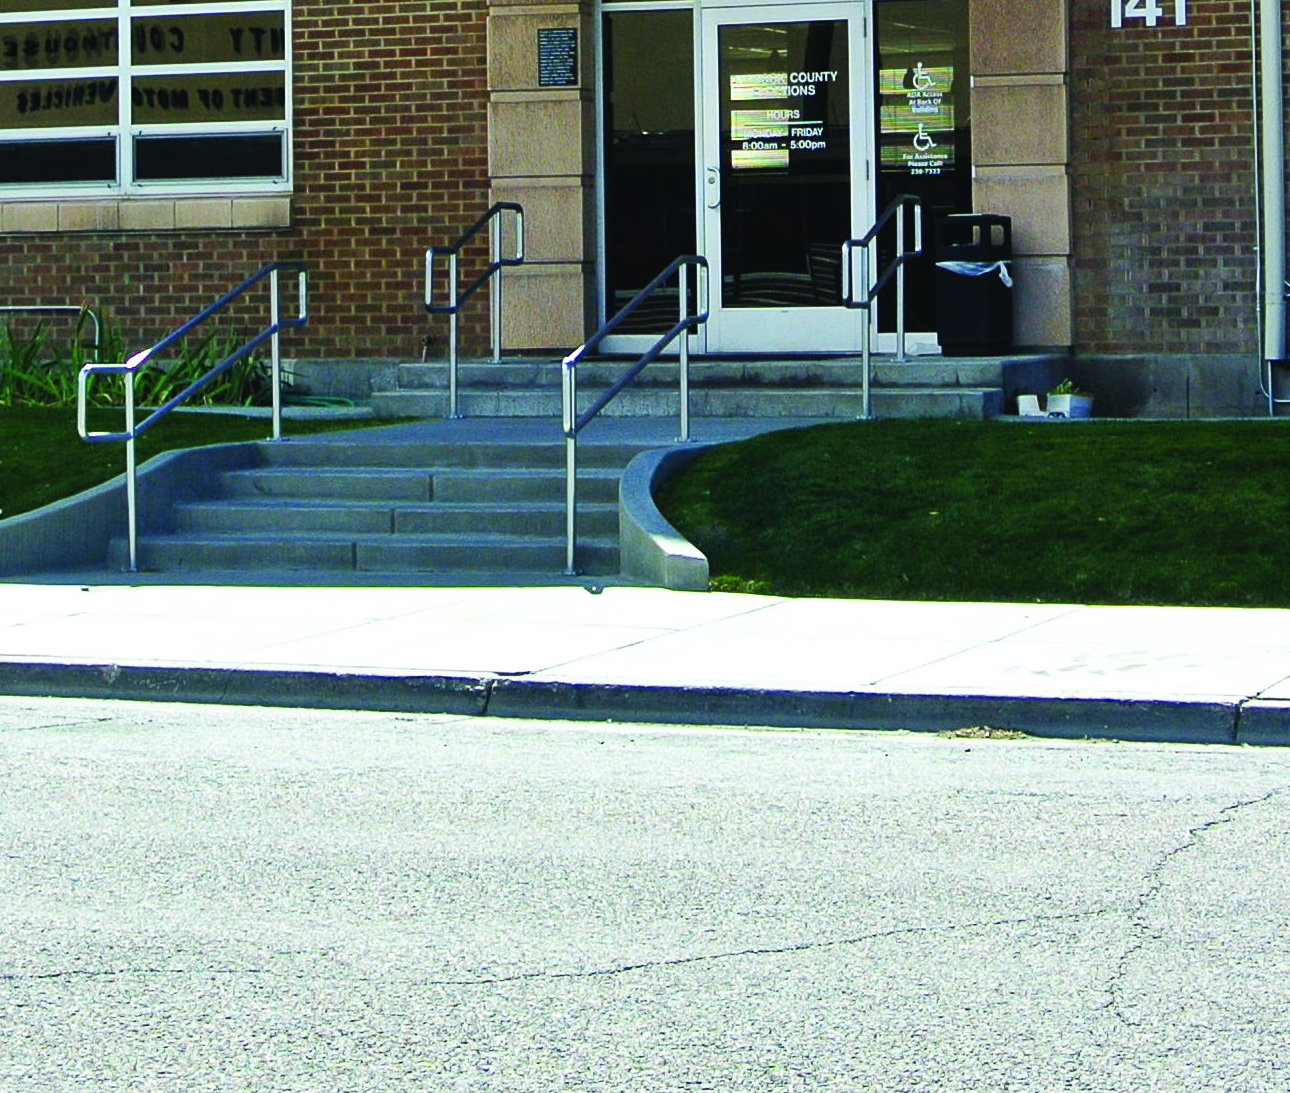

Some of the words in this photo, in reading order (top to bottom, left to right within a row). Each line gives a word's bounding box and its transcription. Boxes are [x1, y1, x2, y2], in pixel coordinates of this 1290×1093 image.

[789, 71, 838, 83] COUNTY
[766, 110, 800, 120] HOURS
[791, 127, 823, 137] FRIDAY
[790, 140, 826, 150] 5:00pm
